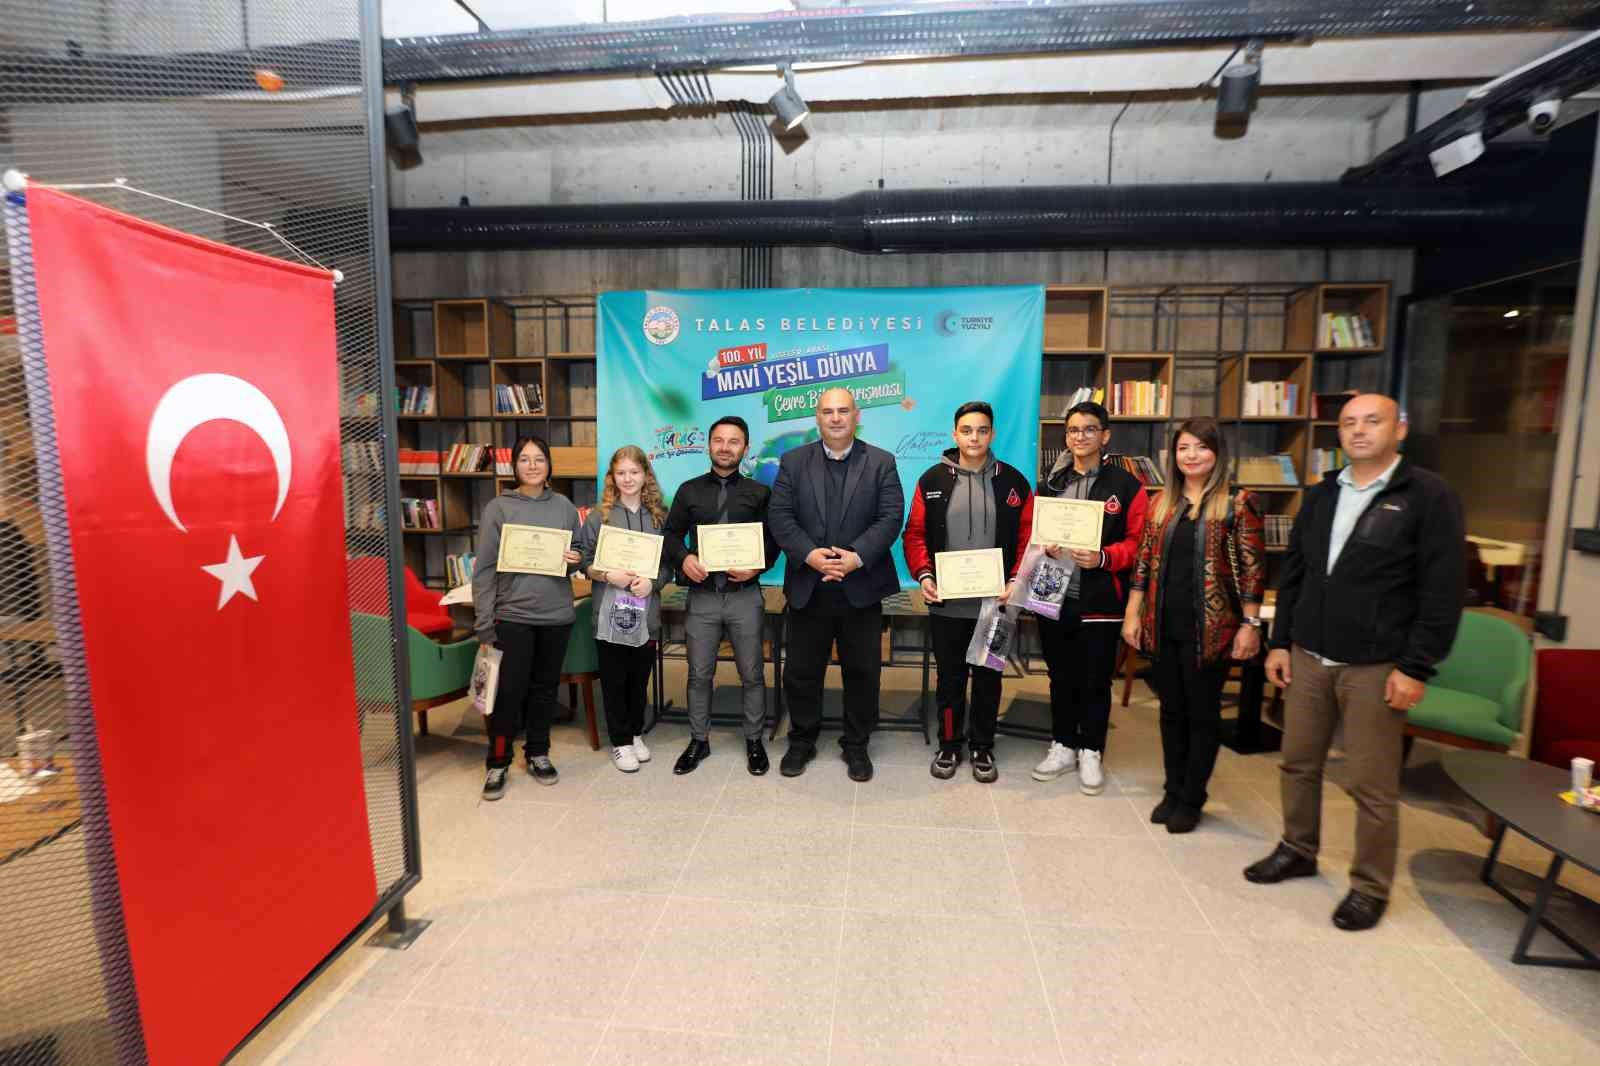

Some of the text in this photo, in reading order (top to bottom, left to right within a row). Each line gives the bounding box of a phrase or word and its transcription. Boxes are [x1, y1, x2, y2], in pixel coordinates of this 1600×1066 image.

[695, 318, 766, 331] TALAS
[720, 348, 765, 364] 100. YIL
[717, 350, 877, 393] MAVİ YEŞİL DÜNYA
[774, 393, 806, 417] Çevre
